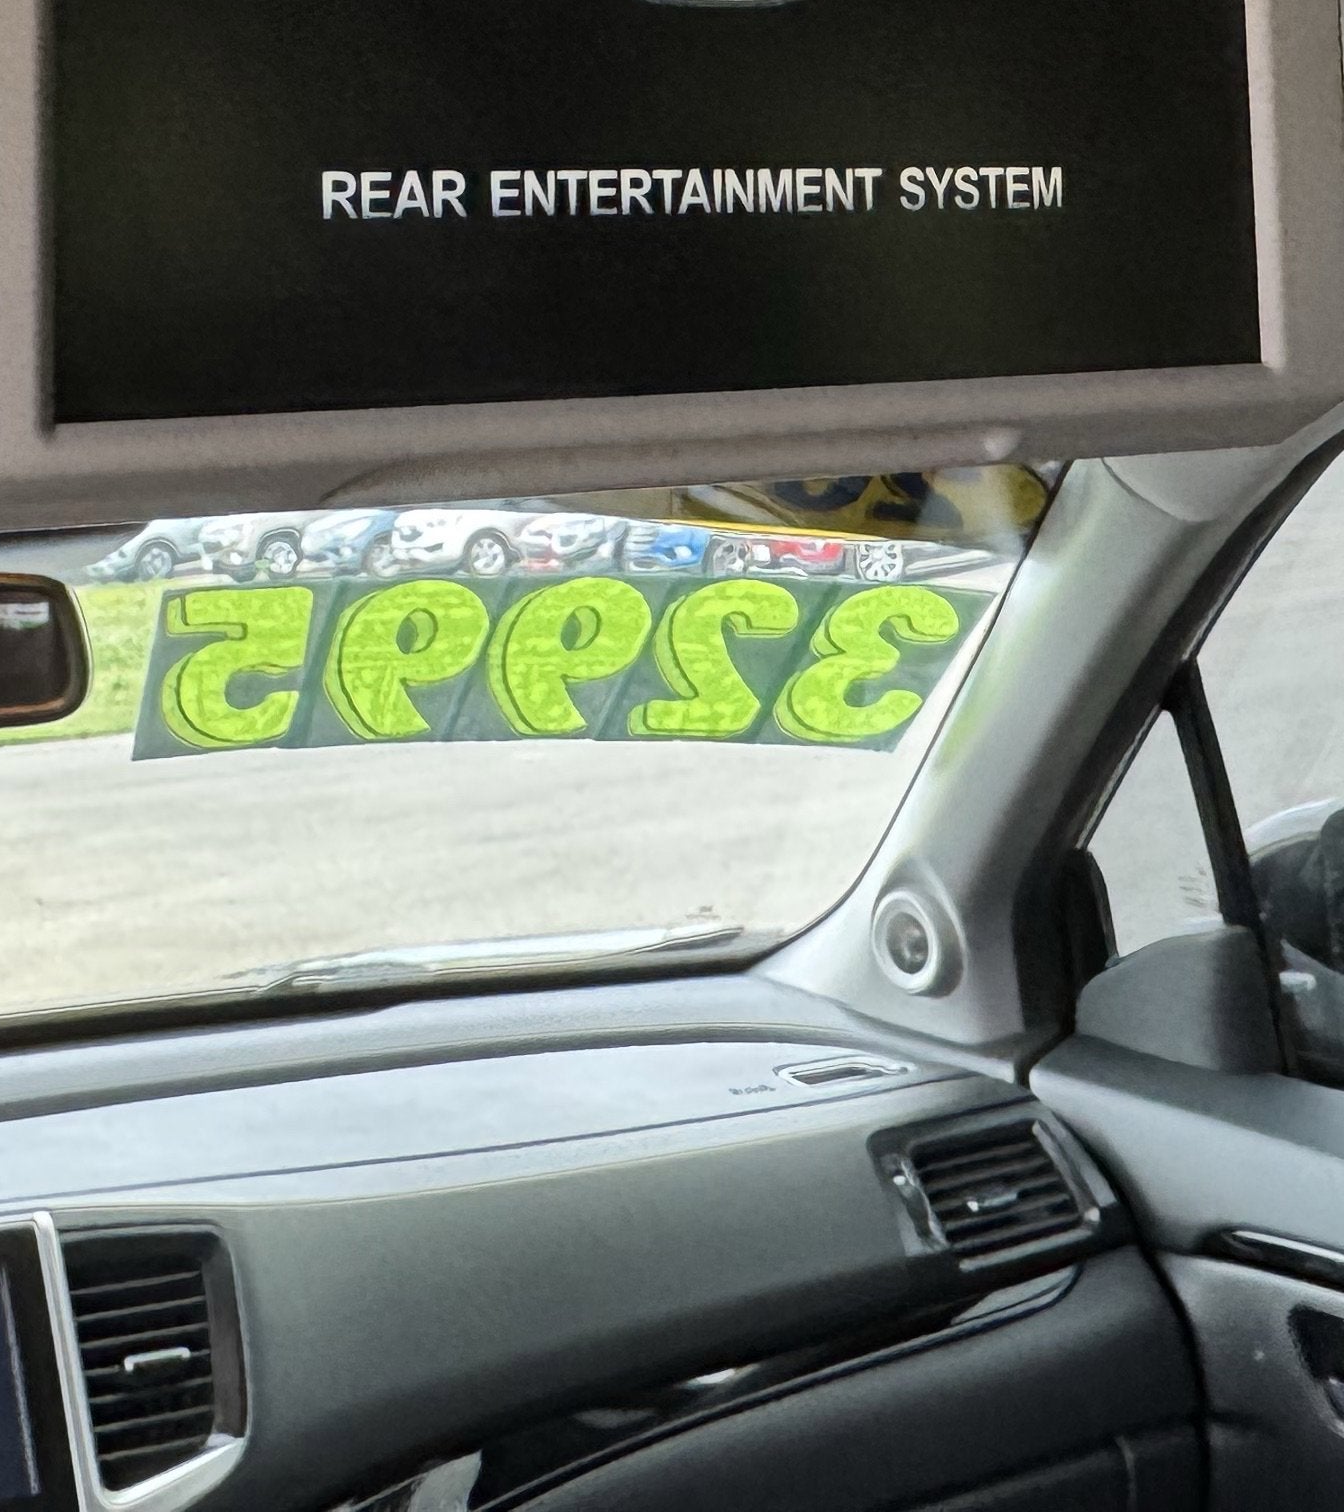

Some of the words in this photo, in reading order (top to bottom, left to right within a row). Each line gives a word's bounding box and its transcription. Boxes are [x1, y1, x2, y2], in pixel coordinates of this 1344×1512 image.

[321, 169, 468, 221] REAR
[488, 167, 884, 218] ENTERTAINMENT
[898, 165, 1065, 212] SYSTEM
